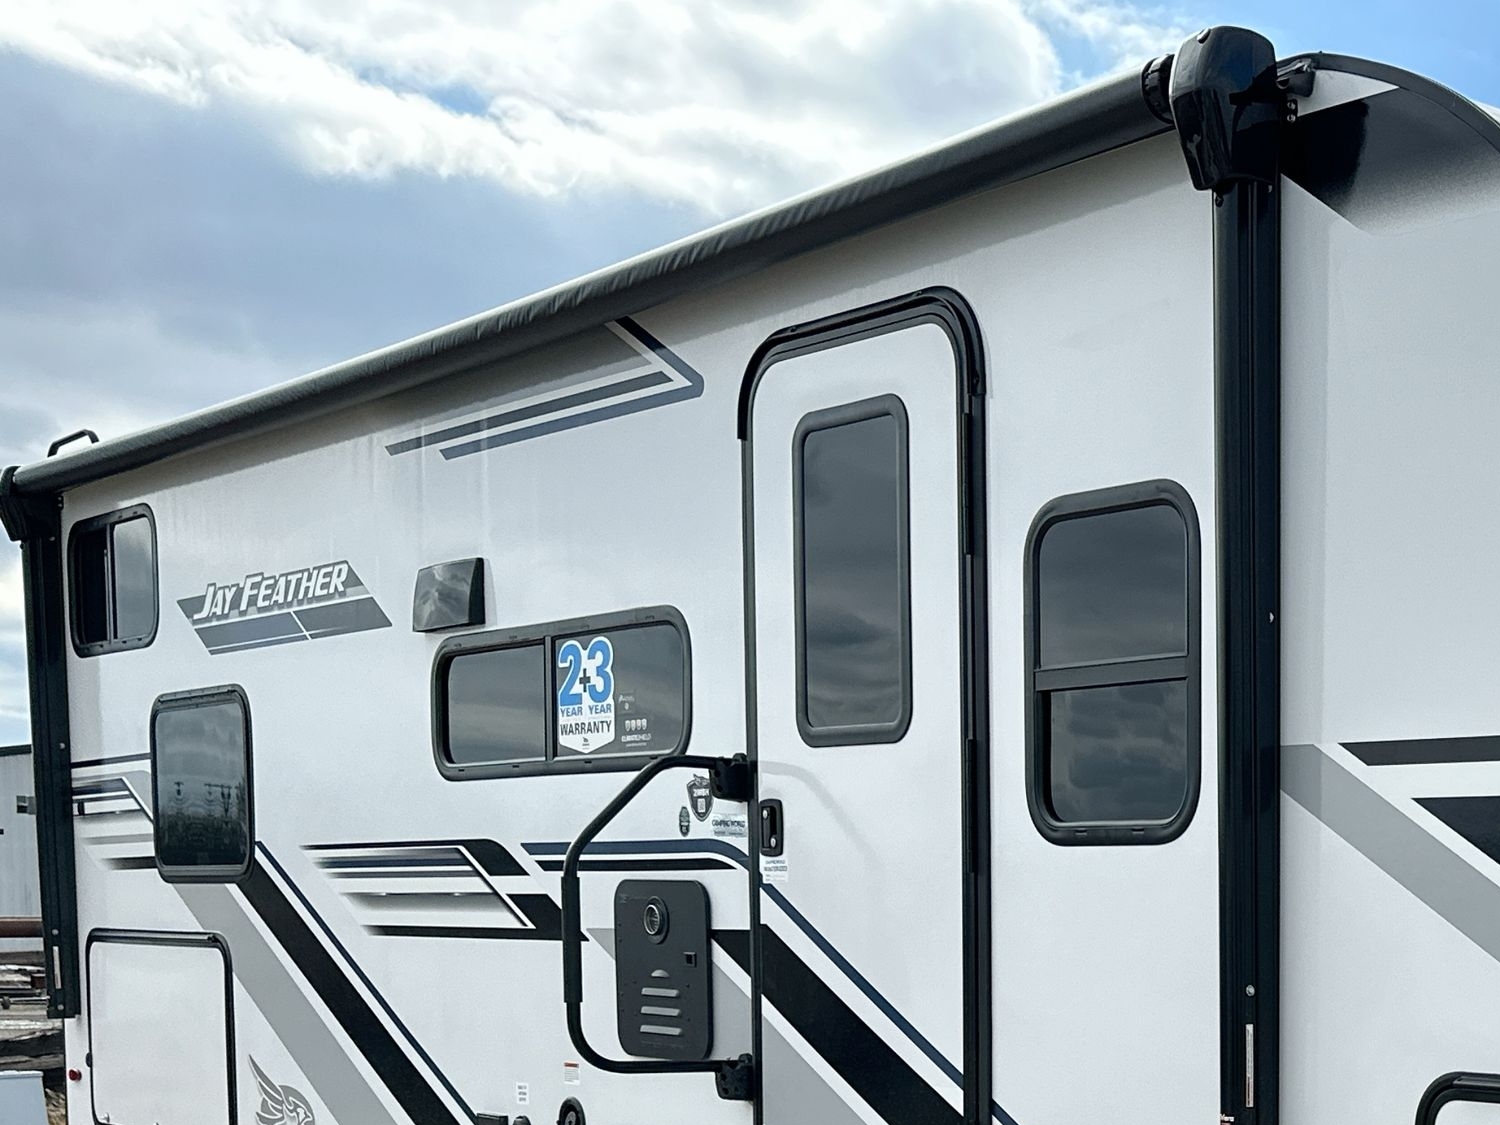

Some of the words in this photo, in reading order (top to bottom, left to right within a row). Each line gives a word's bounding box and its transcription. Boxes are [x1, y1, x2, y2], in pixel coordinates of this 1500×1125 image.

[192, 584, 237, 620] JAY
[239, 562, 350, 612] FEATHER
[560, 706, 583, 718] YEAR
[588, 703, 612, 715] YEAR
[560, 719, 612, 736] WARRANTY
